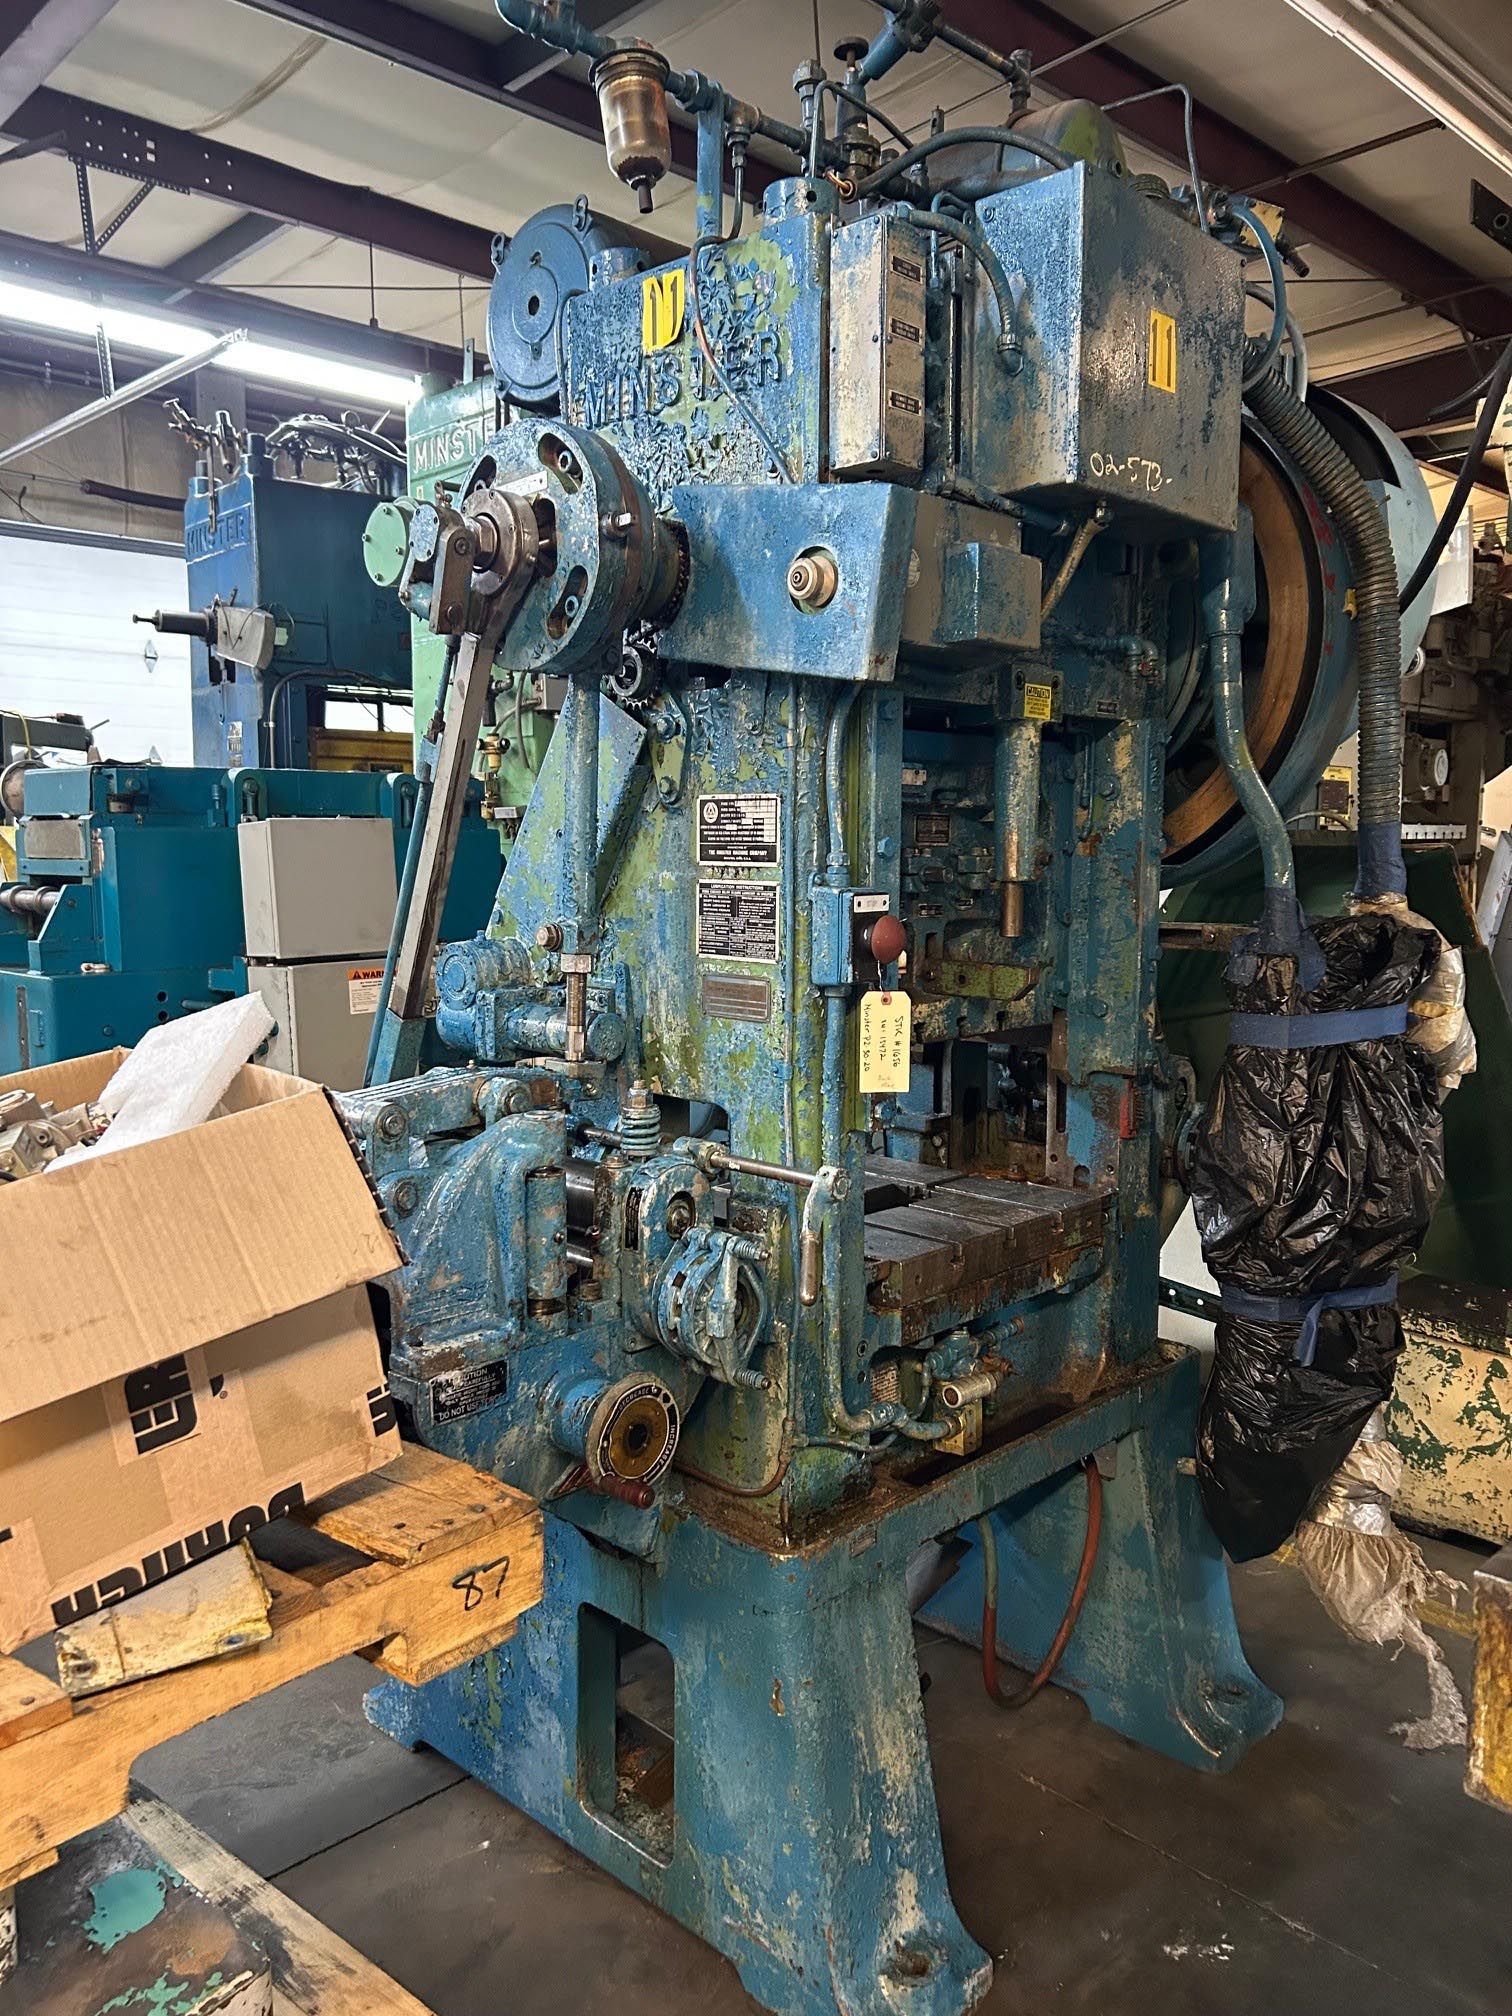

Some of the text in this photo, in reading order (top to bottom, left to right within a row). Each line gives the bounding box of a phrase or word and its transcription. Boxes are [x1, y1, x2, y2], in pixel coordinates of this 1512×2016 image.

[187, 512, 246, 556] MINTER
[1027, 686, 1050, 699] CAUTION
[451, 1404, 466, 1416] NOT
[659, 1424, 677, 1466] INCREASE
[452, 1555, 510, 1611] 87
